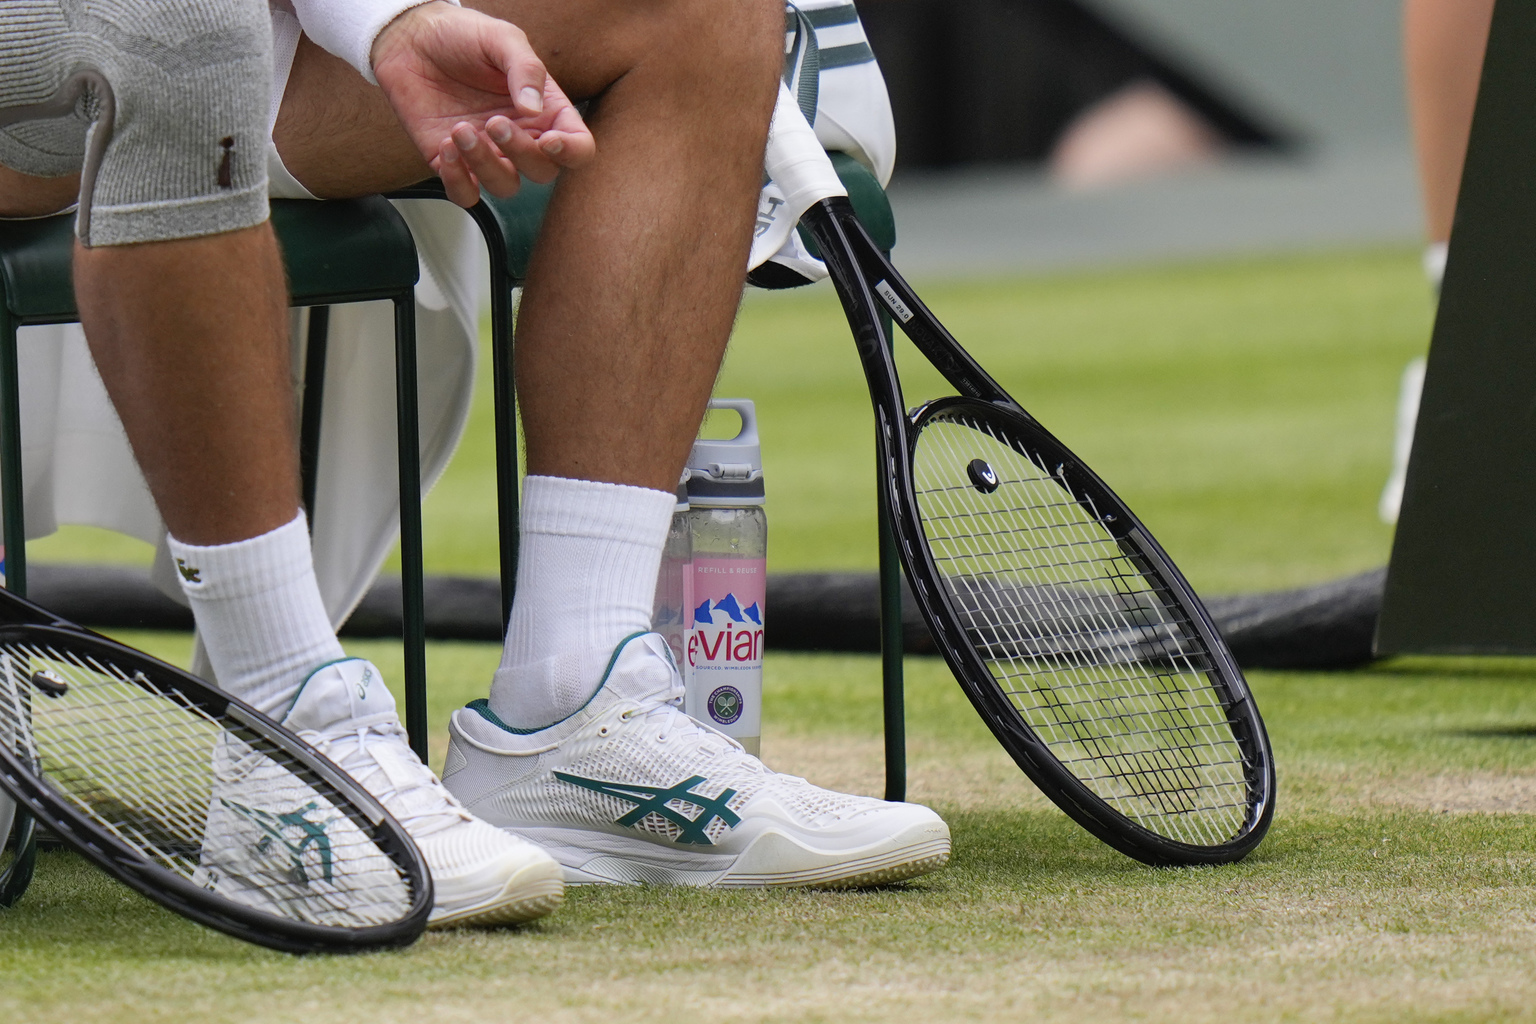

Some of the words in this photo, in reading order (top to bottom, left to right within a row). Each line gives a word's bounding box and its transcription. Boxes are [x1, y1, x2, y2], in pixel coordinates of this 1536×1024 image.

[884, 290, 897, 305] SUN
[698, 566, 727, 574] REFILL
[687, 622, 764, 668] evian
